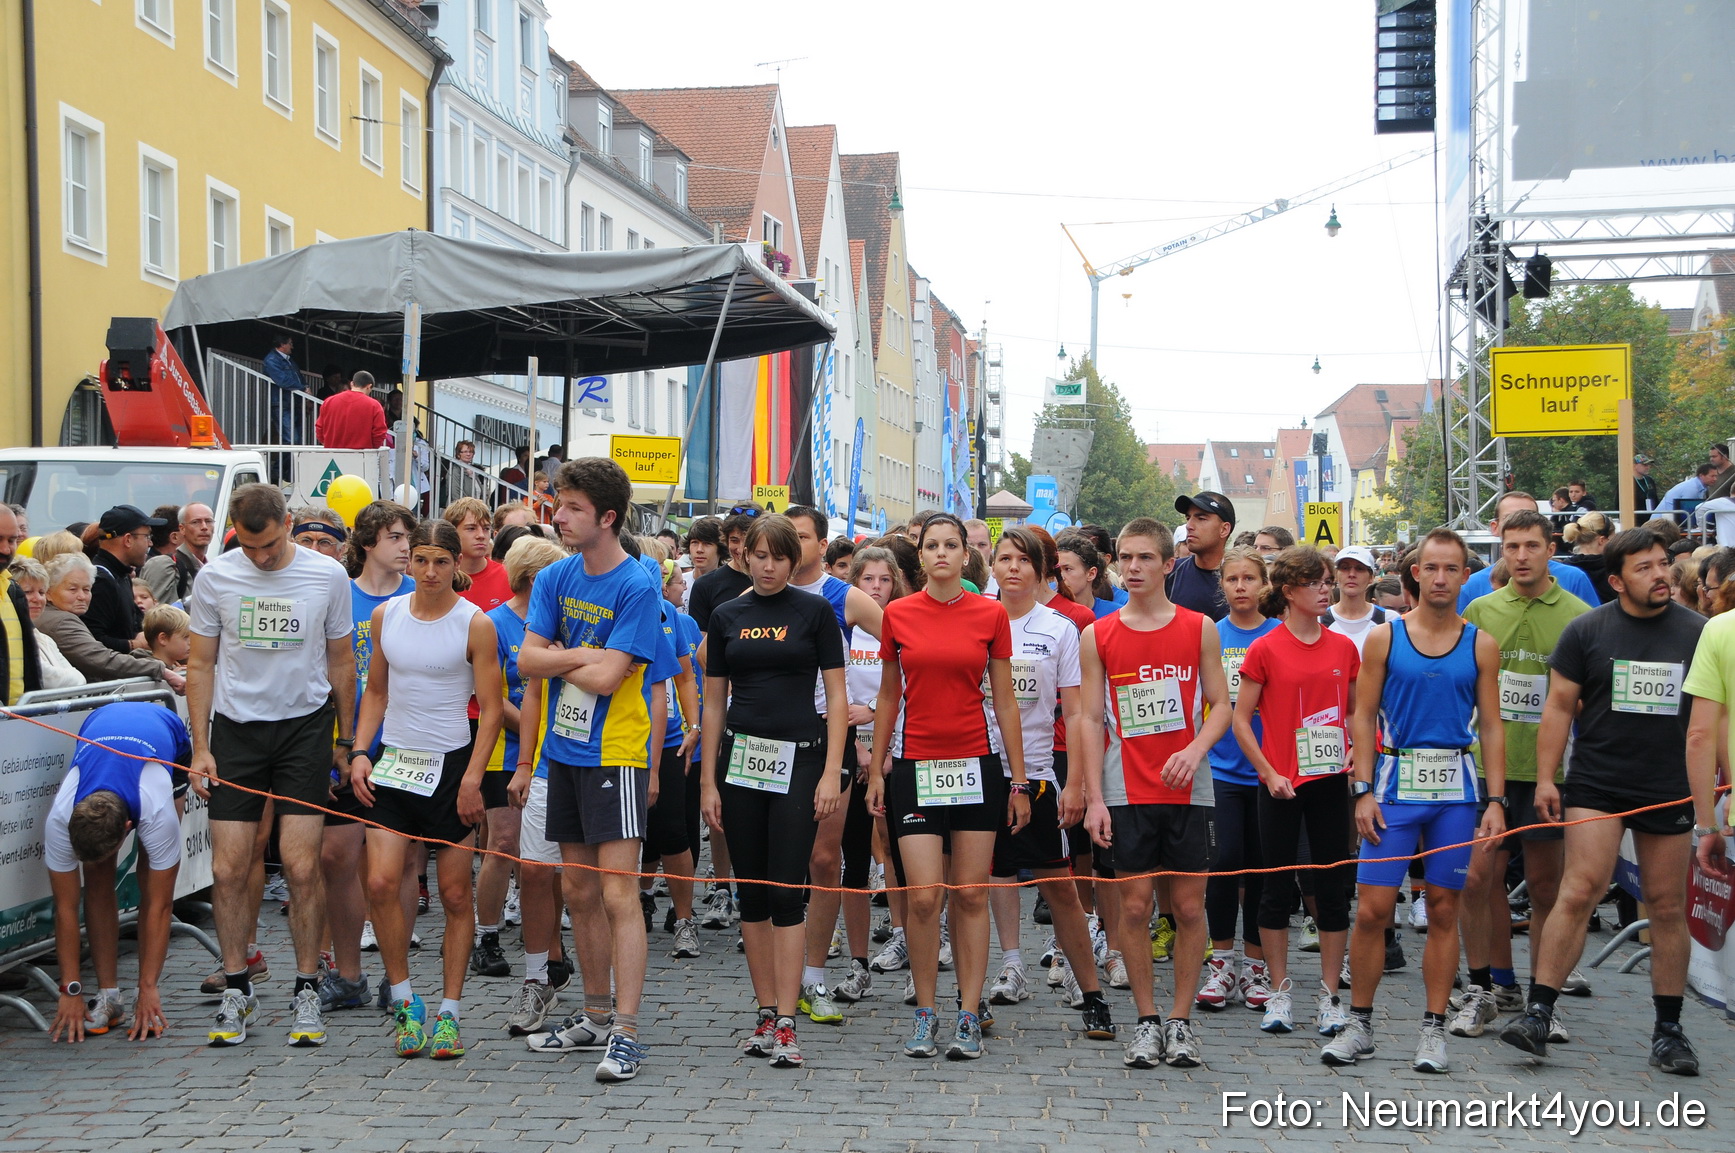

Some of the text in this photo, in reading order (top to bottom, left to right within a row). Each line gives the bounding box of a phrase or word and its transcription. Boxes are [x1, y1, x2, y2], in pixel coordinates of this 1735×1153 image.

[1163, 239, 1188, 252] POTAIN
[168, 359, 183, 388] Jura
[1500, 373, 1619, 392] Schnupper-
[1058, 385, 1081, 396] DAV
[1541, 396, 1579, 413] lauf
[615, 448, 676, 460] Schnupper-
[635, 461, 655, 472] lauf
[756, 487, 785, 498] Block
[1308, 504, 1339, 515] Block
[1314, 519, 1335, 545] A
[257, 601, 292, 612] Matthes
[565, 597, 614, 620] NEUMARKTER
[563, 607, 601, 625] STADTLAUF
[258, 617, 300, 633] 5129
[358, 621, 371, 629] NE
[740, 627, 783, 640] ROXY
[850, 649, 880, 660] ME
[1231, 661, 1242, 669] So
[1632, 665, 1673, 677] Christian
[1139, 664, 1192, 682] EnBW
[1231, 674, 1240, 687] 5
[1503, 674, 1532, 688] Thomas
[1132, 688, 1156, 700] Björn
[1632, 682, 1675, 697] 5002
[1502, 691, 1540, 707] 5046
[560, 704, 588, 723] 5254
[1137, 698, 1178, 718] 5172
[1312, 713, 1329, 725] DEHN
[1311, 730, 1338, 739] Melanie
[748, 740, 779, 754] Isabella
[1314, 745, 1343, 758] 5091
[1, 752, 65, 776] Gebäudereinigung
[398, 753, 440, 767] Konstantin
[747, 756, 787, 776] 5042
[933, 760, 967, 769] Vanessa
[394, 768, 435, 784] 5186
[935, 772, 976, 788] 5015
[1418, 768, 1457, 783] 5157
